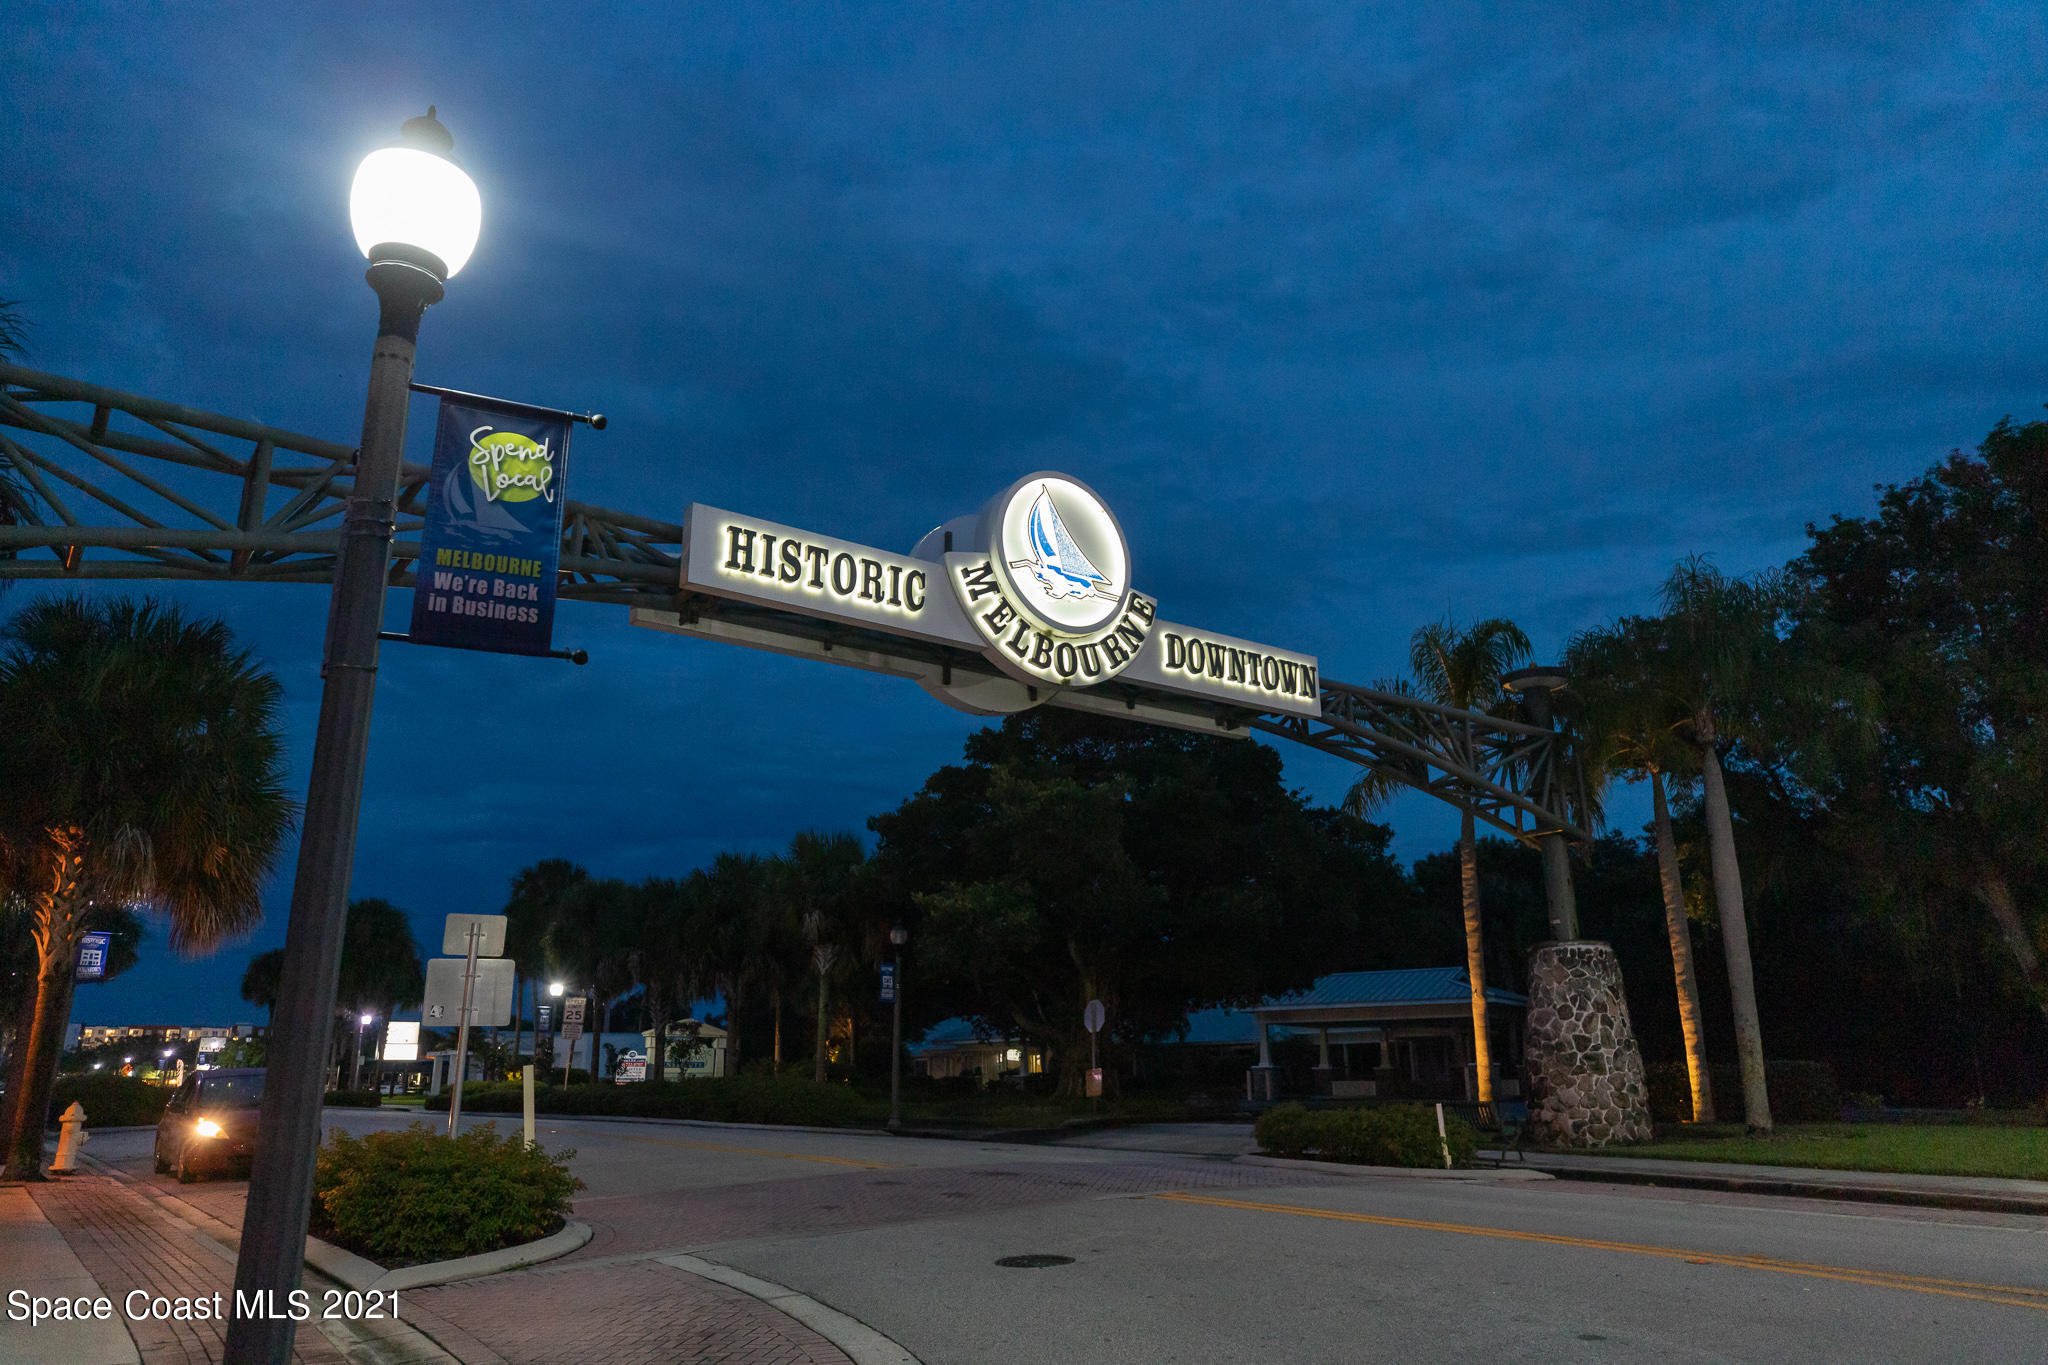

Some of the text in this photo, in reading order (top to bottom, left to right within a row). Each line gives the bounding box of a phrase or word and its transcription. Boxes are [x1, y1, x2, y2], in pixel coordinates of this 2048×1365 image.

[470, 425, 554, 470] Spend
[481, 466, 554, 503] Local
[436, 548, 542, 578] MELBOURNE
[725, 525, 926, 612] HISTORIC
[434, 572, 539, 601] We're Back
[428, 593, 539, 624] in Business
[961, 561, 1157, 679] MELBOURNE
[1165, 633, 1318, 699] DOWNTOWN
[566, 1010, 582, 1020] 25
